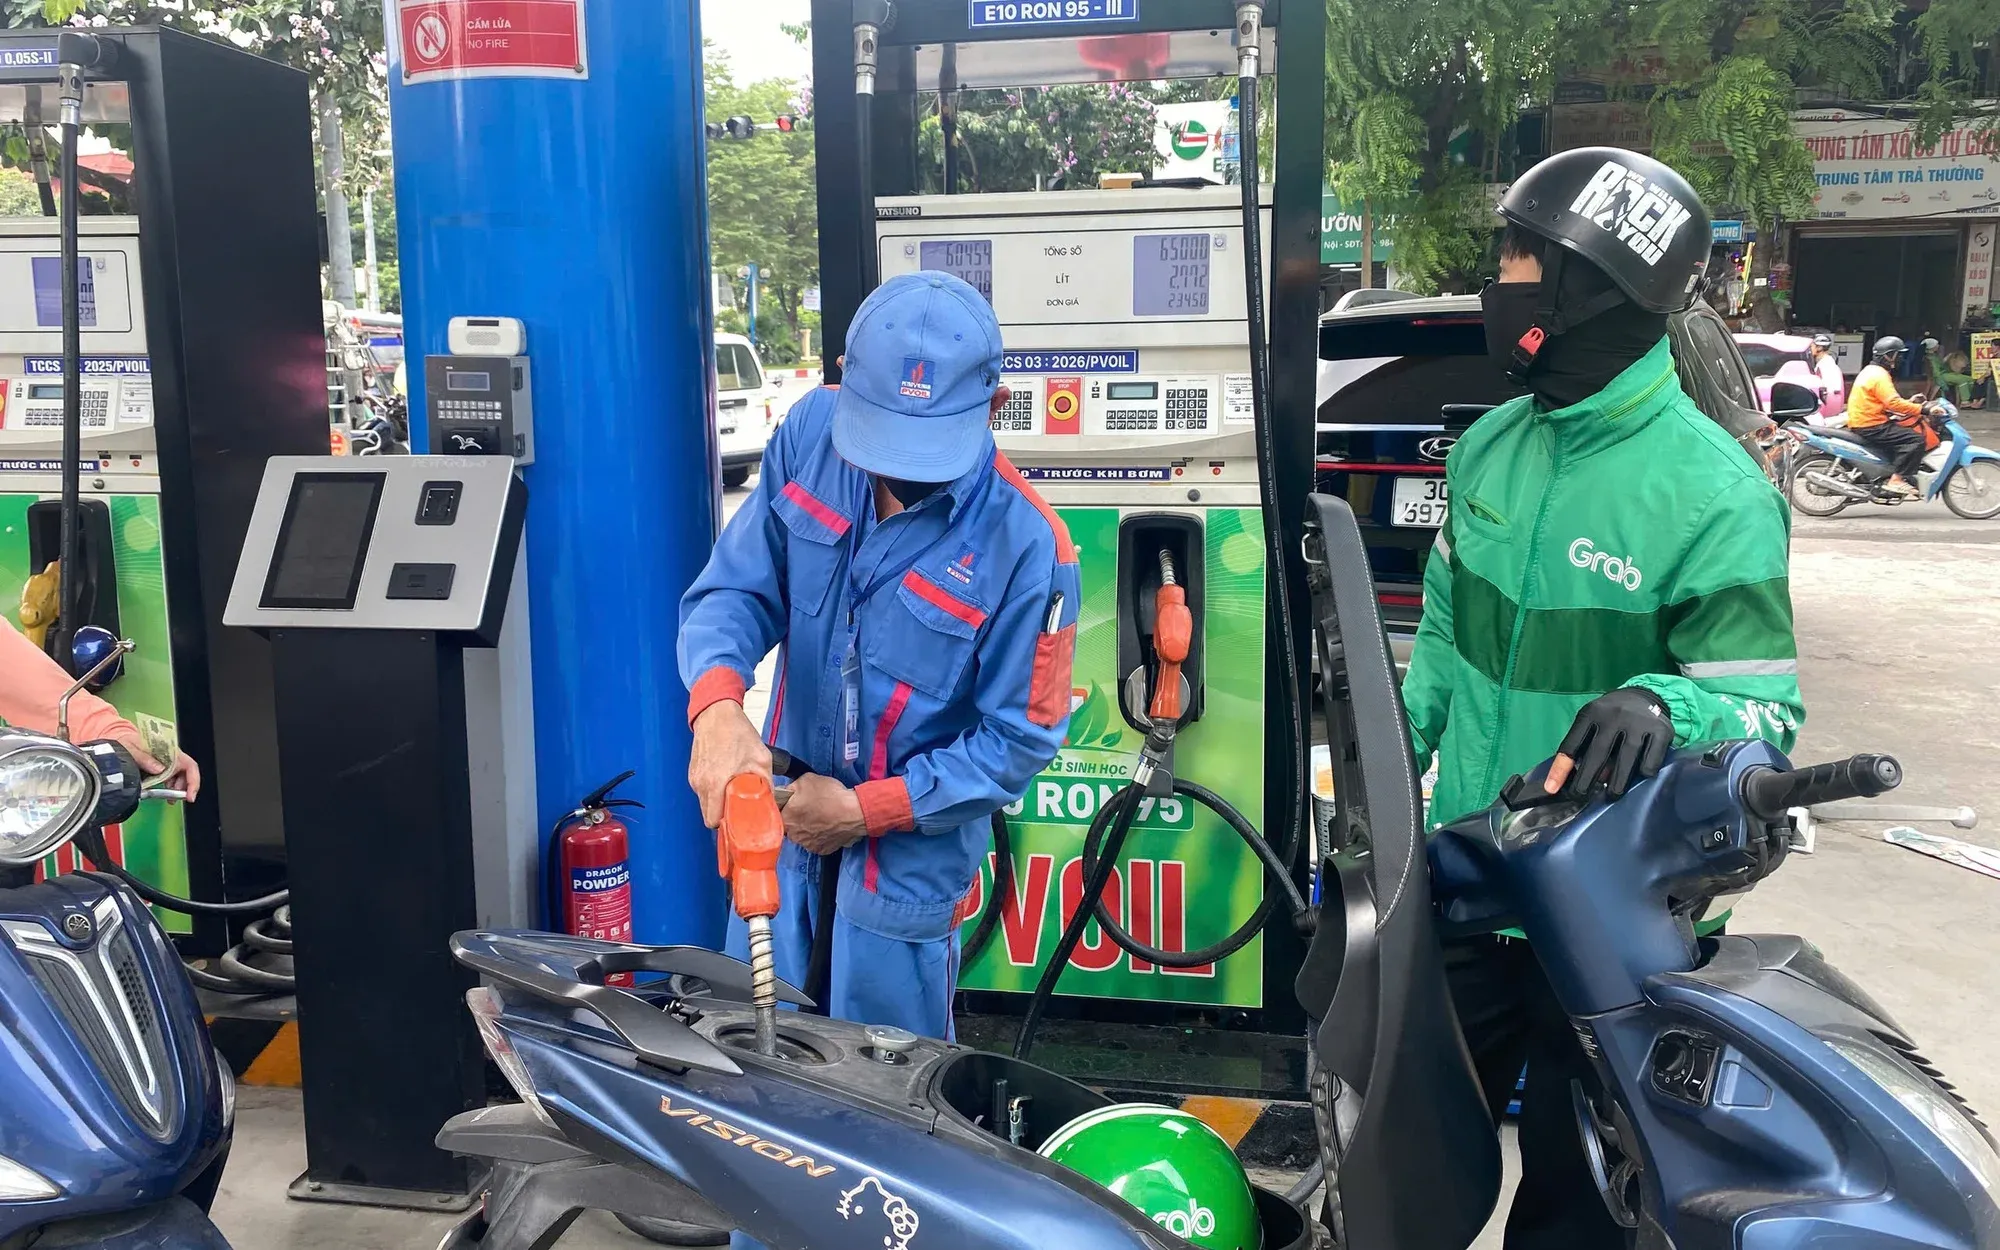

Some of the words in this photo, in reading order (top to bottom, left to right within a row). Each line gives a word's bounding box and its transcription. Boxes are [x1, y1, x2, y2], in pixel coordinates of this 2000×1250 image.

[985, 4, 1017, 21] E10
[1021, 2, 1061, 19] RON
[1065, 1, 1089, 17] 95
[466, 17, 489, 29] CẤM
[493, 17, 511, 29] LỬA
[468, 40, 482, 48] NO
[486, 39, 509, 48] FIRE
[1626, 169, 1646, 183] WE
[1815, 172, 1859, 186] TRUNG
[1864, 169, 1893, 184] TÂM
[1898, 165, 1923, 183] TRẢ
[1928, 164, 1984, 182] THƯỞNG
[876, 207, 919, 216] TATSUNO
[1569, 160, 1693, 252] ROCK
[1160, 236, 1208, 261] 65000
[1616, 219, 1664, 266] YOU
[1056, 273, 1069, 284] LÍT
[1047, 298, 1064, 307] ĐƠN
[1065, 297, 1079, 305] GIÁ
[1168, 292, 1207, 308] 23450
[30, 360, 60, 372] TCCS
[84, 360, 150, 372] 2025/PVOIL
[1025, 356, 1042, 369] 03
[1052, 354, 1129, 369] 2026/PVOIL
[901, 388, 929, 398] PVOIL
[40, 461, 61, 469] KHI
[1042, 467, 1093, 478] TRƯỚC
[1097, 469, 1123, 478] KHI
[1127, 469, 1163, 478] BƠM
[1568, 537, 1642, 591] Grab
[1065, 762, 1096, 774] SINH
[1099, 764, 1128, 777] HỌC
[586, 865, 622, 877] DRAGON
[573, 870, 629, 890] POWDER
[660, 1094, 837, 1178] VISION
